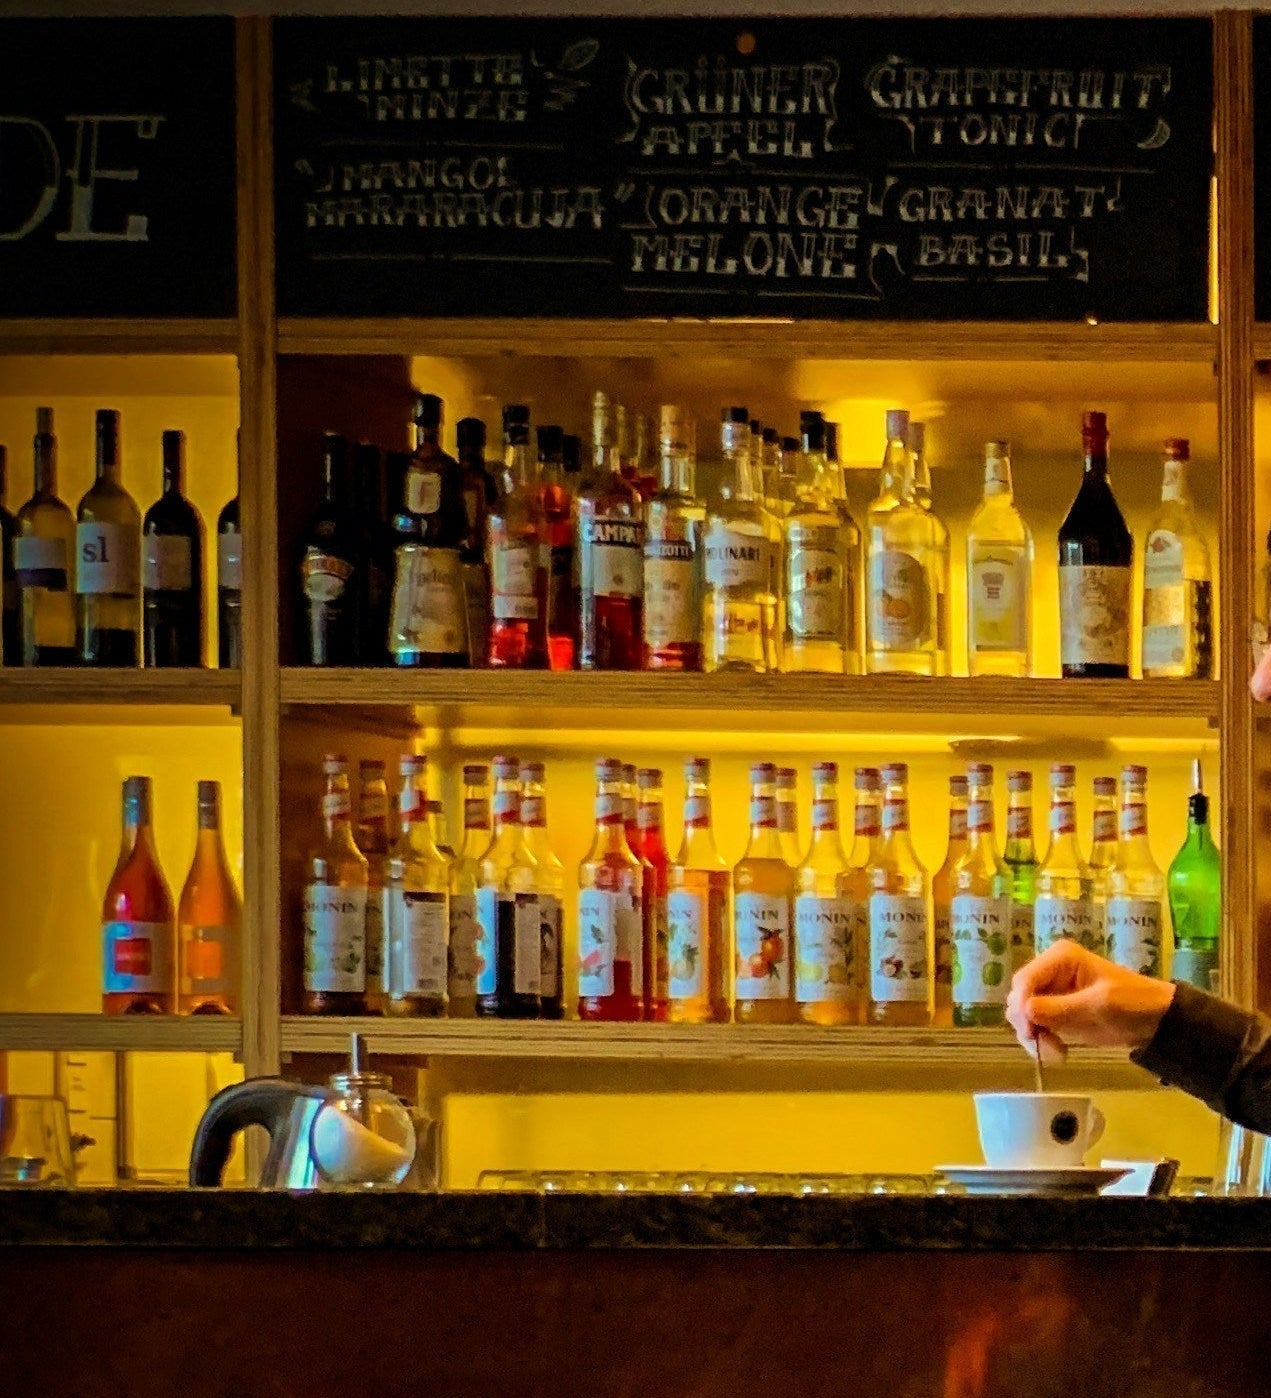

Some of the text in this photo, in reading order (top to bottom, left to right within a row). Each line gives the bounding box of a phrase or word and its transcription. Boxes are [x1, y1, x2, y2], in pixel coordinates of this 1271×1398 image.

[632, 54, 829, 115] GRÜNER
[868, 60, 1162, 110] GRAPEFRUIT
[373, 88, 528, 122] MINZE
[641, 120, 814, 158] APFEL
[919, 112, 1070, 148] TONIC
[657, 185, 863, 230] ORANGE
[899, 185, 1105, 222] GRANAT
[631, 231, 859, 279] MELONE
[914, 230, 1068, 268] BASIL
